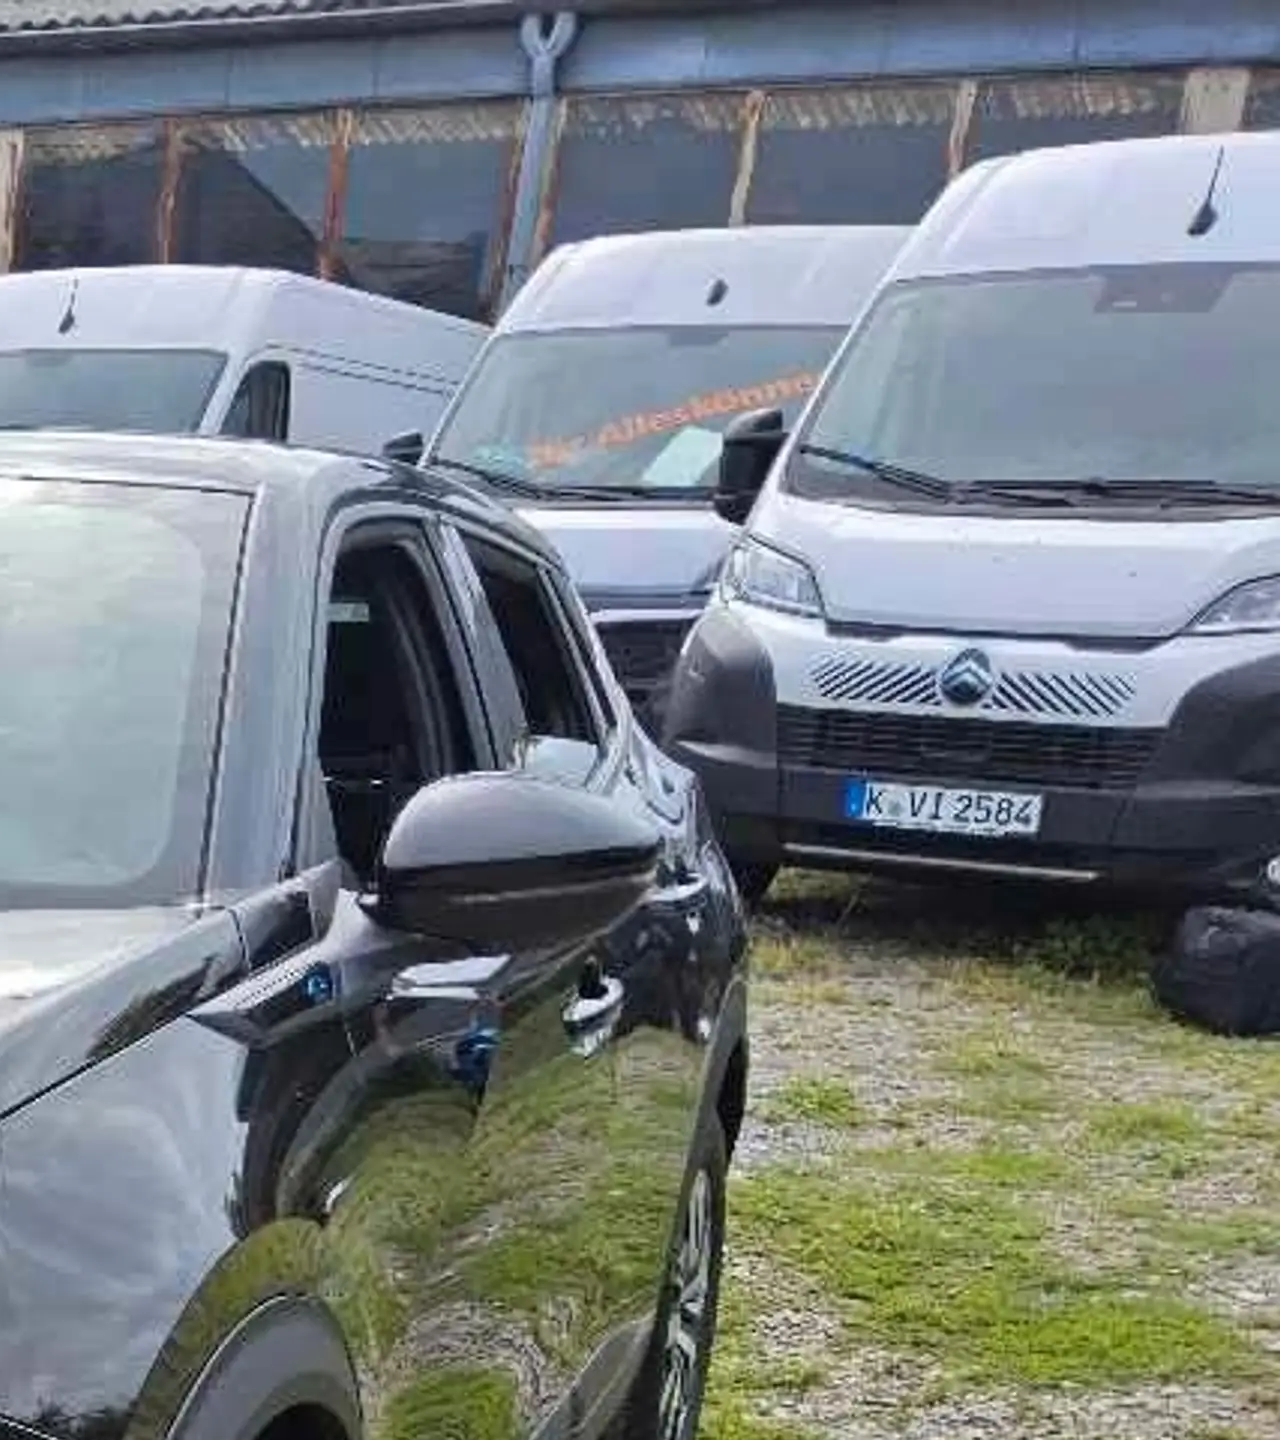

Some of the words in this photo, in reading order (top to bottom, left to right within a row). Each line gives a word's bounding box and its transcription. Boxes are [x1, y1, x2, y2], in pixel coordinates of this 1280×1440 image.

[867, 786, 884, 816] K
[910, 790, 944, 821] VI
[954, 792, 1033, 826] 2584
